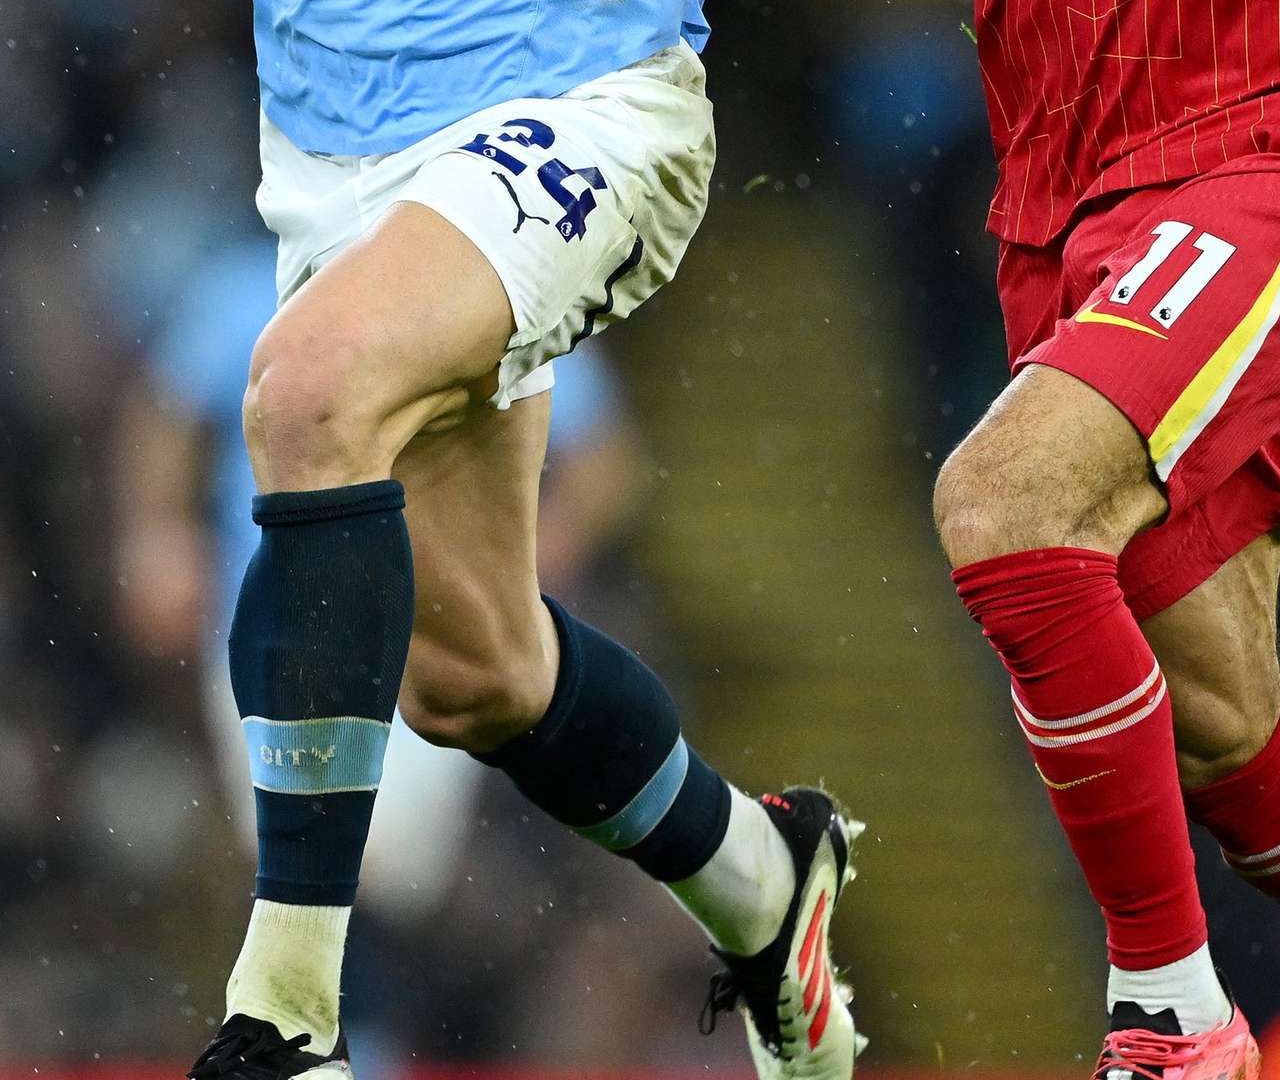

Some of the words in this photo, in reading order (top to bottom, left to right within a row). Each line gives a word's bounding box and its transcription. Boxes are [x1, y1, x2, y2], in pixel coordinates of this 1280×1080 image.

[458, 118, 608, 243] 24
[1109, 220, 1238, 330] 11
[260, 744, 336, 767] CITY
